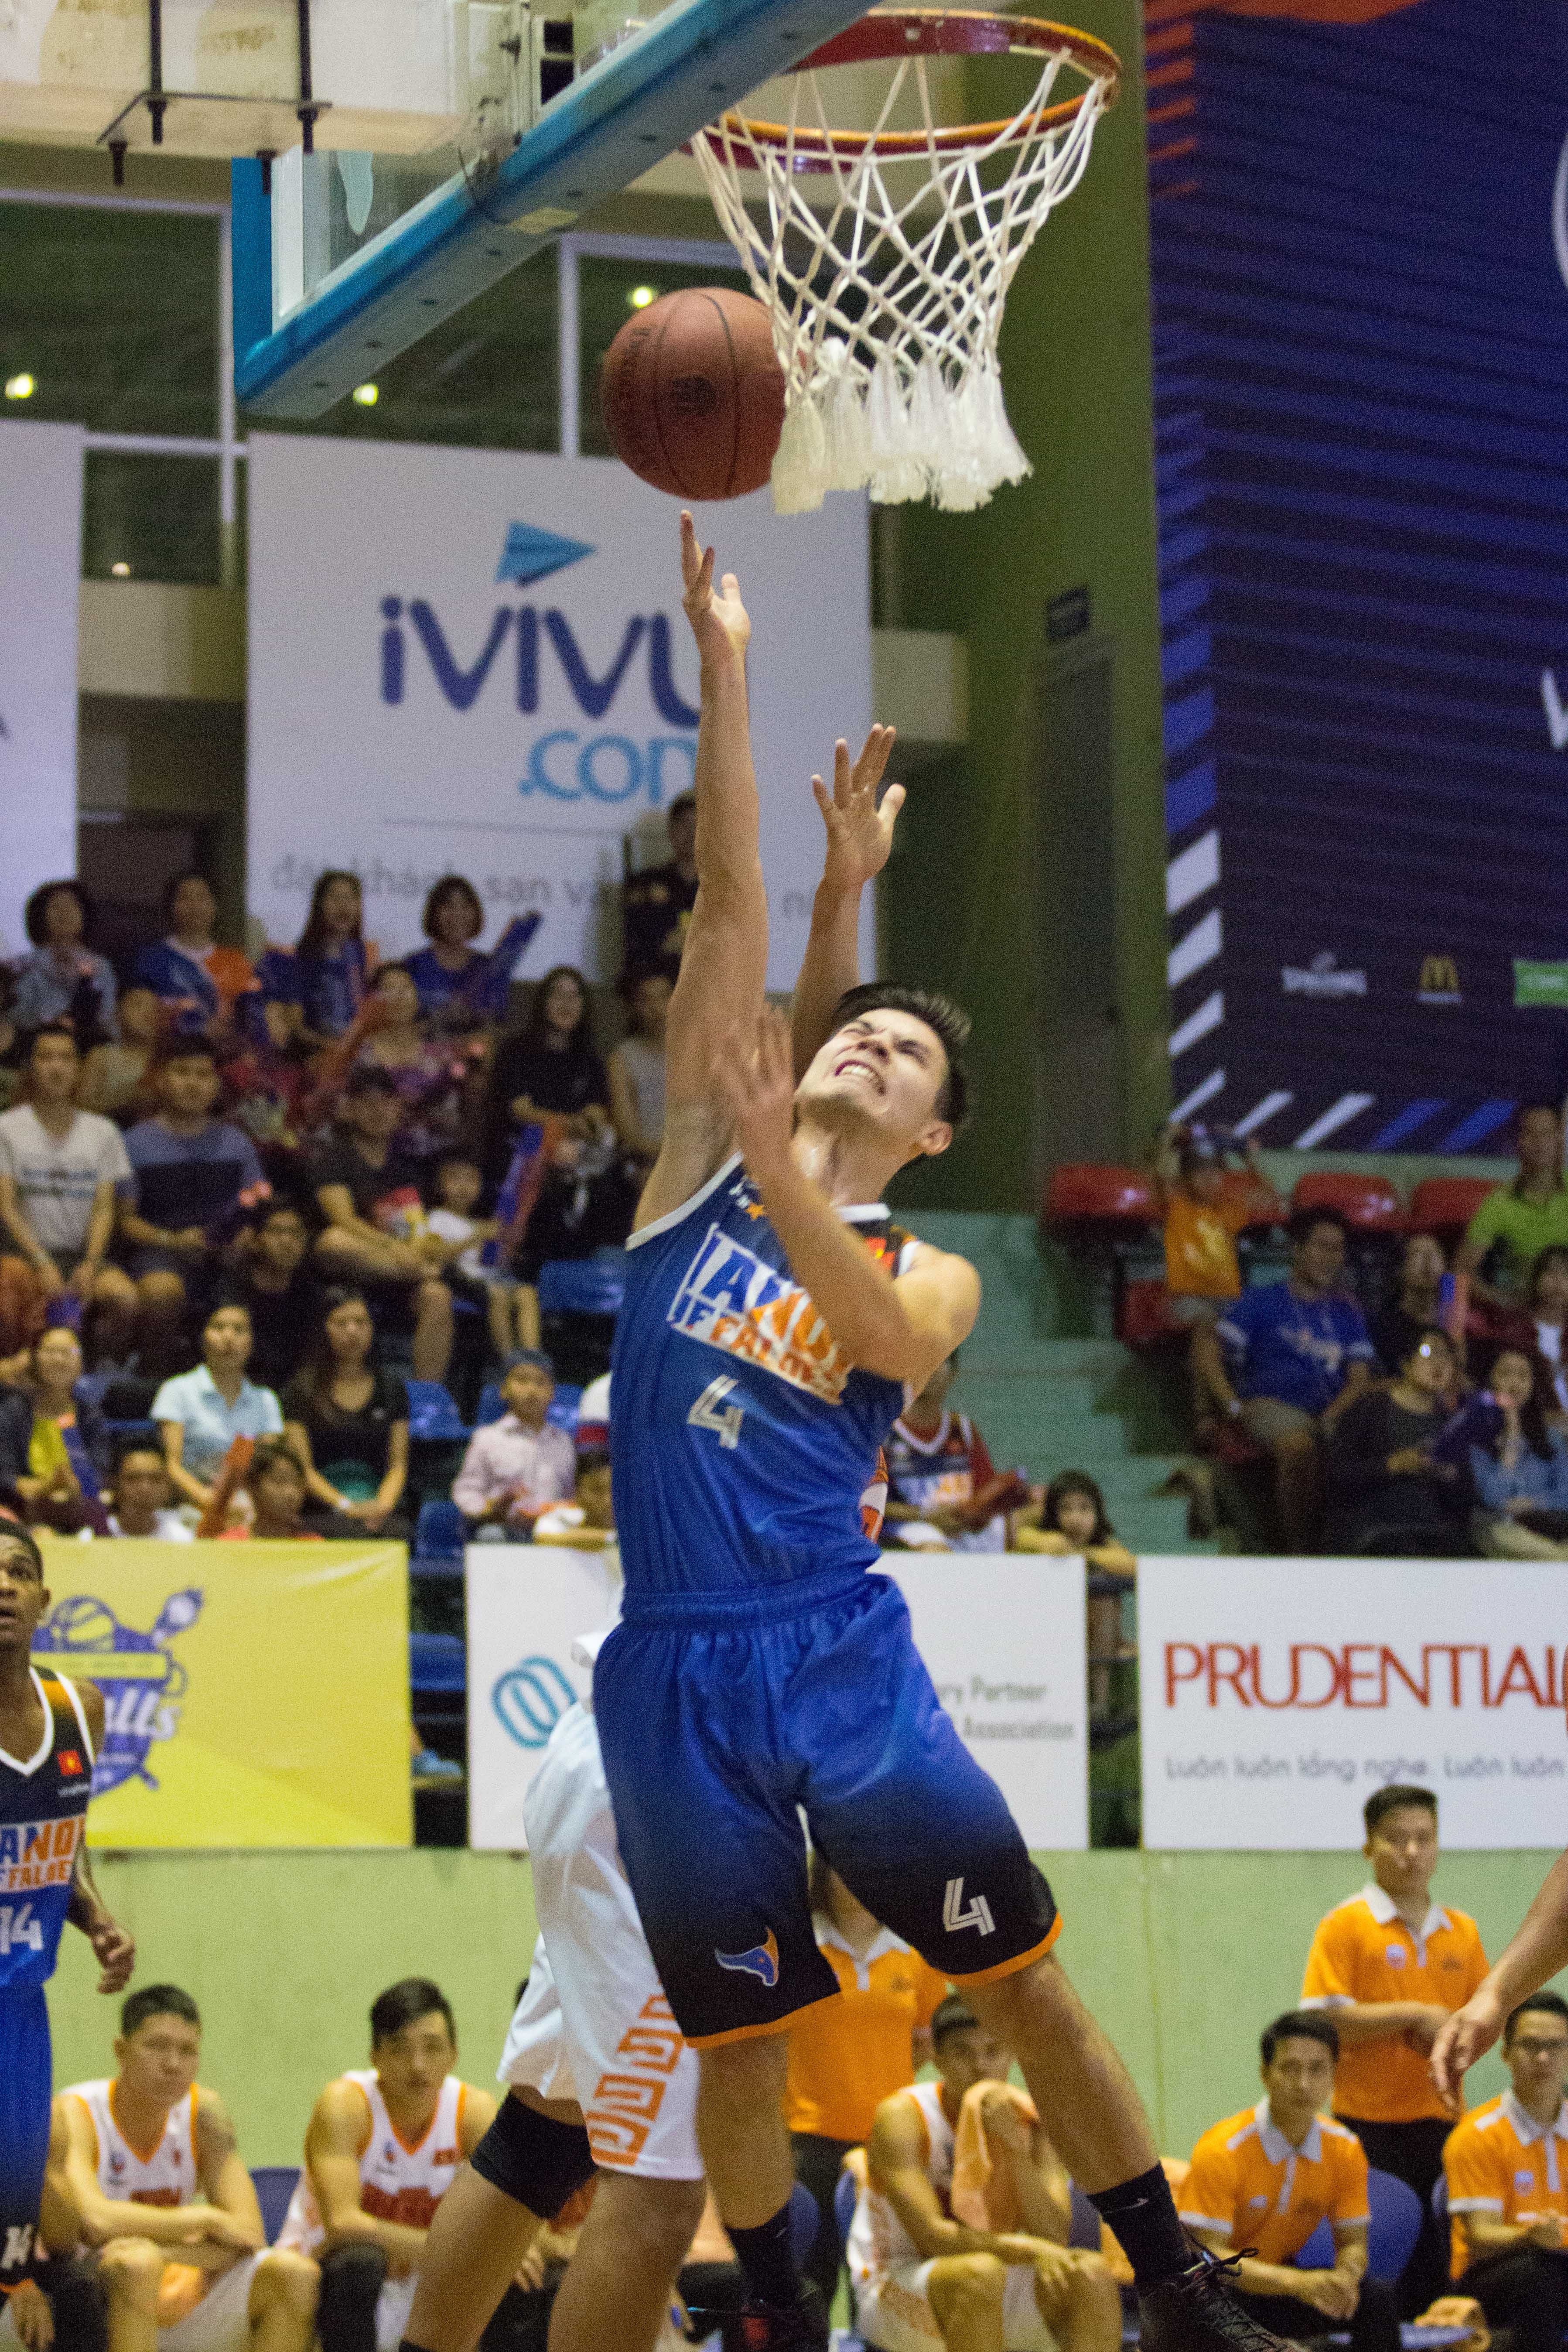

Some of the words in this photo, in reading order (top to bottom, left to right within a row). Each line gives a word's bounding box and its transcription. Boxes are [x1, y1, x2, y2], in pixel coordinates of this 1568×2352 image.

[687, 1374, 744, 1450] 4
[1164, 1641, 1568, 1709] PRUDENTIAL
[942, 1877, 995, 1937] 4
